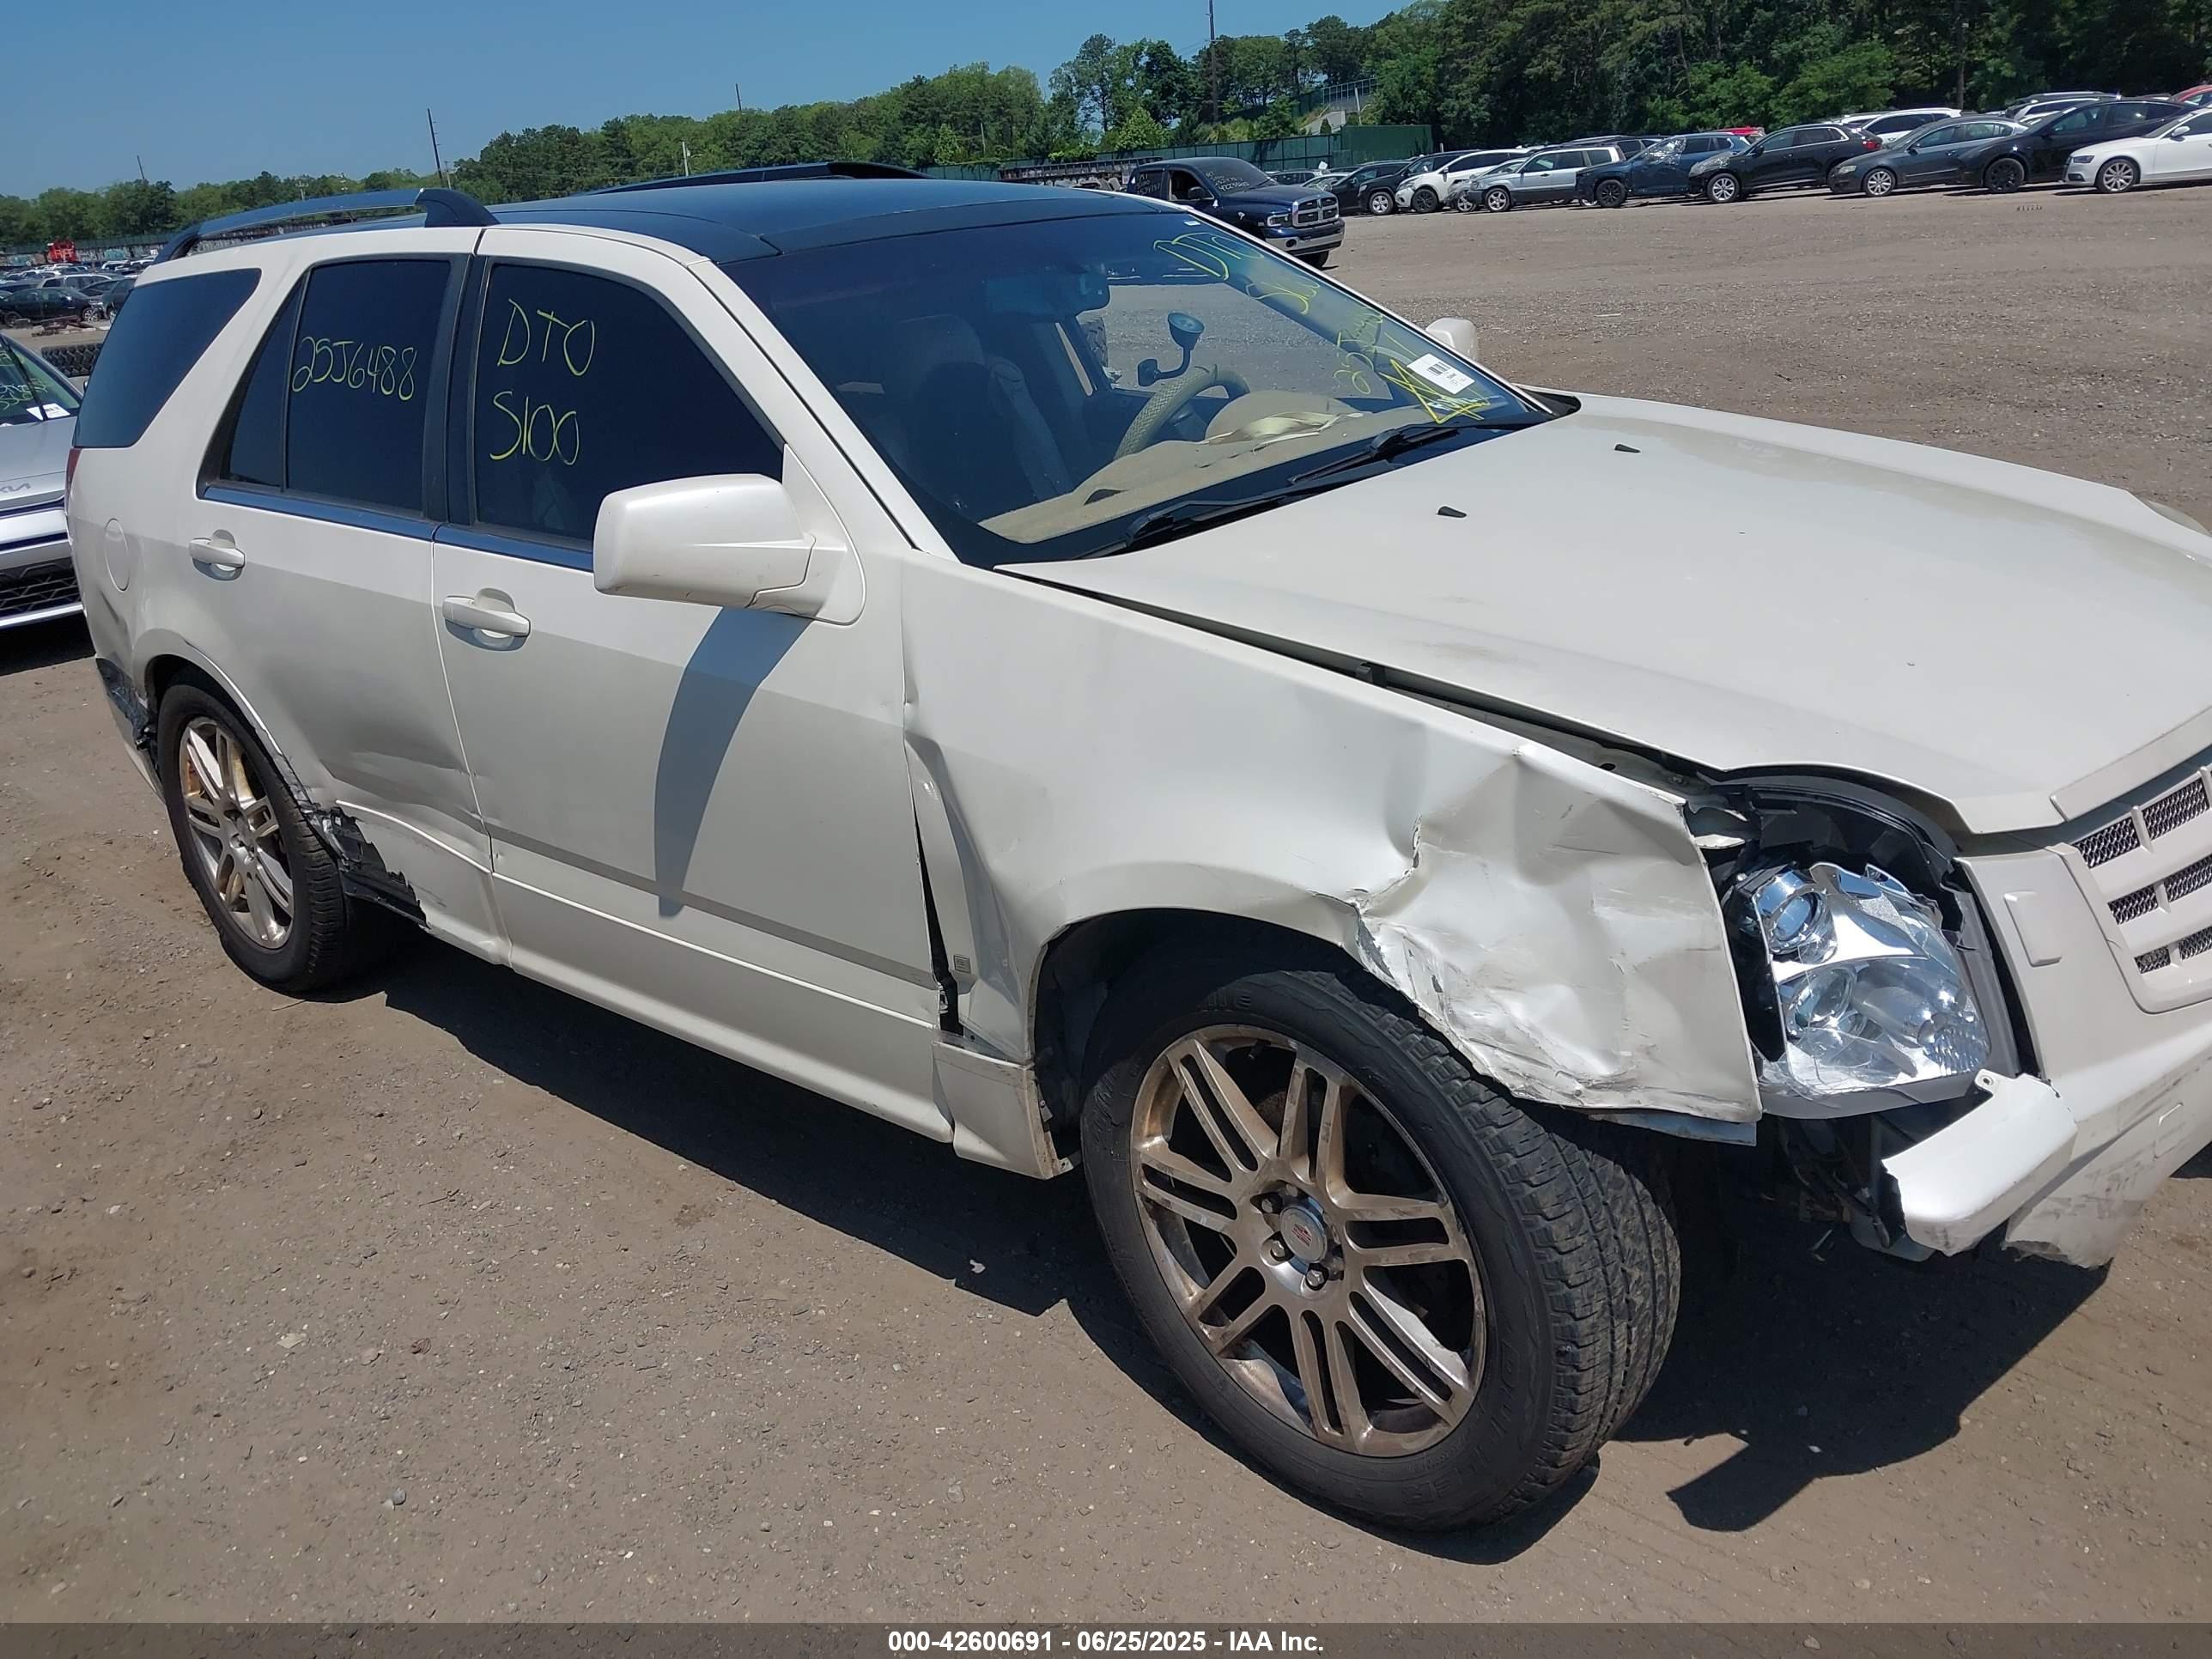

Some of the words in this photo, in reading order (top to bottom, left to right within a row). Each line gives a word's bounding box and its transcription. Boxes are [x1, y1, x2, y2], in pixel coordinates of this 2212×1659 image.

[292, 336, 418, 401] 25J6488
[496, 298, 595, 376] DTO
[489, 391, 580, 465] S100
